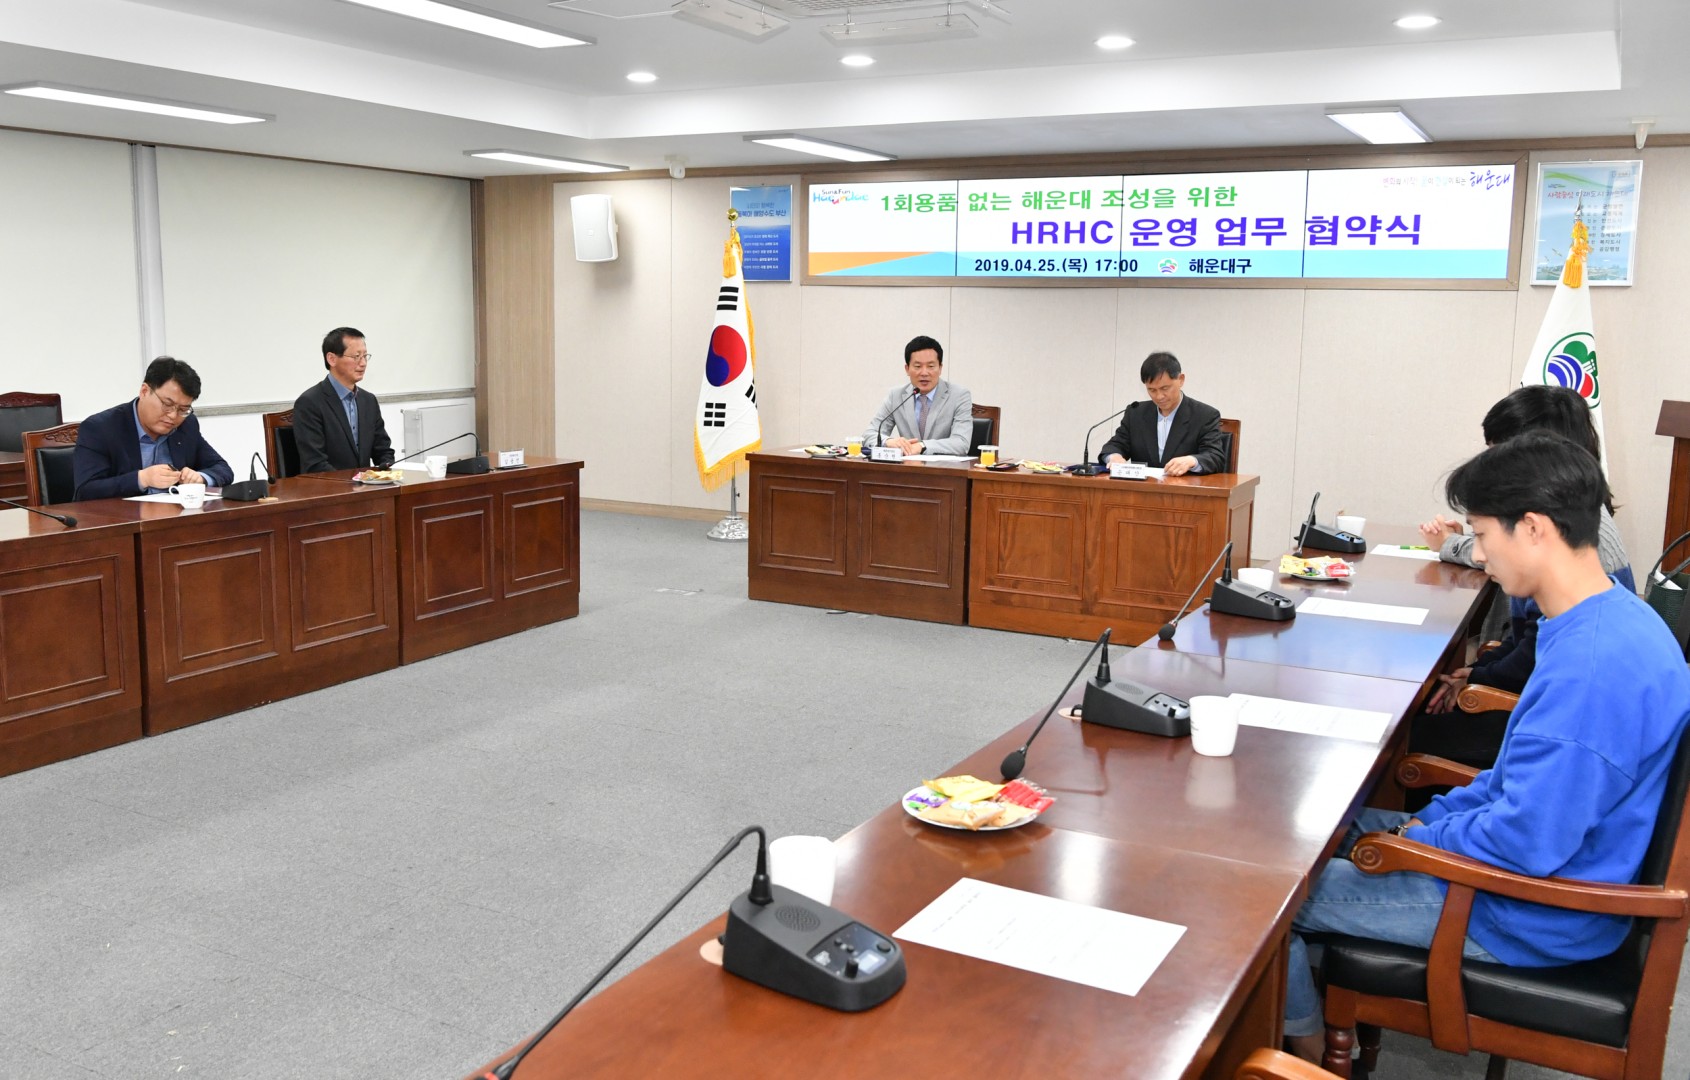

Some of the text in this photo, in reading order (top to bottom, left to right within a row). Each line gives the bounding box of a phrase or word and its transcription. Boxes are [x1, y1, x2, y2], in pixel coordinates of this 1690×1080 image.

[1470, 169, 1511, 191] 해운대
[881, 186, 1238, 213] 1회용품 없는 해운대 조성을 위한
[1011, 214, 1422, 247] HRHC 운영 업무 협약식
[975, 257, 1138, 274] 2019.04.25.(목) 17:00
[1189, 258, 1252, 274] 해운대구
